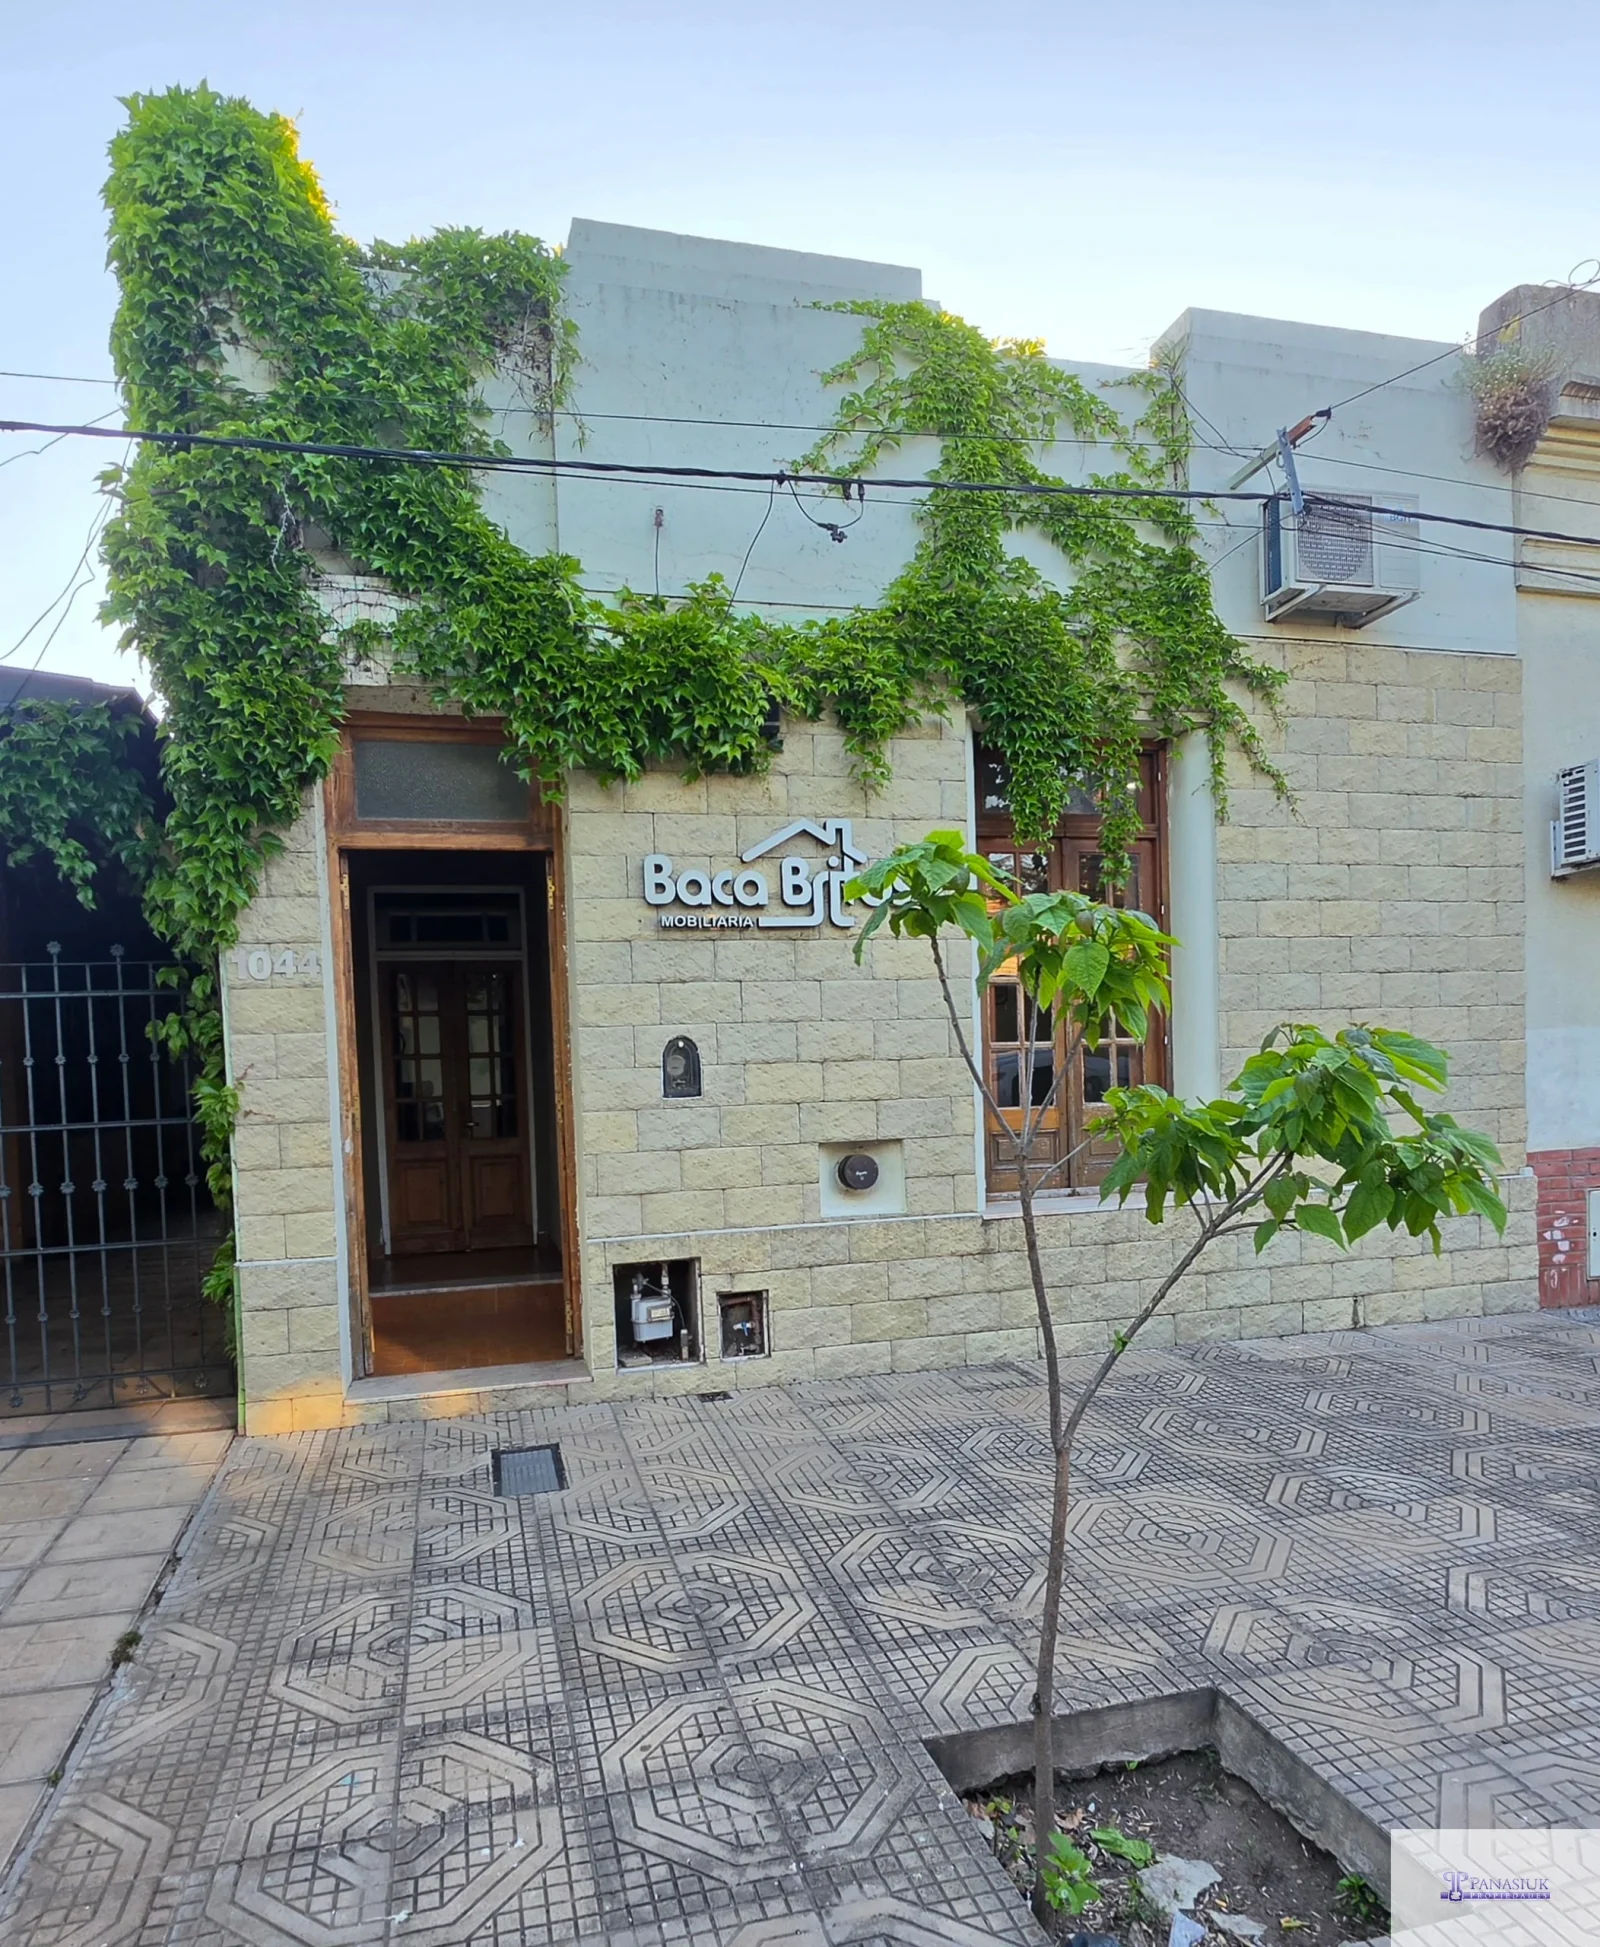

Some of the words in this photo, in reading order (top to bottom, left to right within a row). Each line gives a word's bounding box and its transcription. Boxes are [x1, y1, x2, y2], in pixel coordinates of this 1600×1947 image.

[643, 853, 768, 906] Baca
[661, 914, 754, 929] MOBILIARIA
[231, 948, 322, 981] 1044
